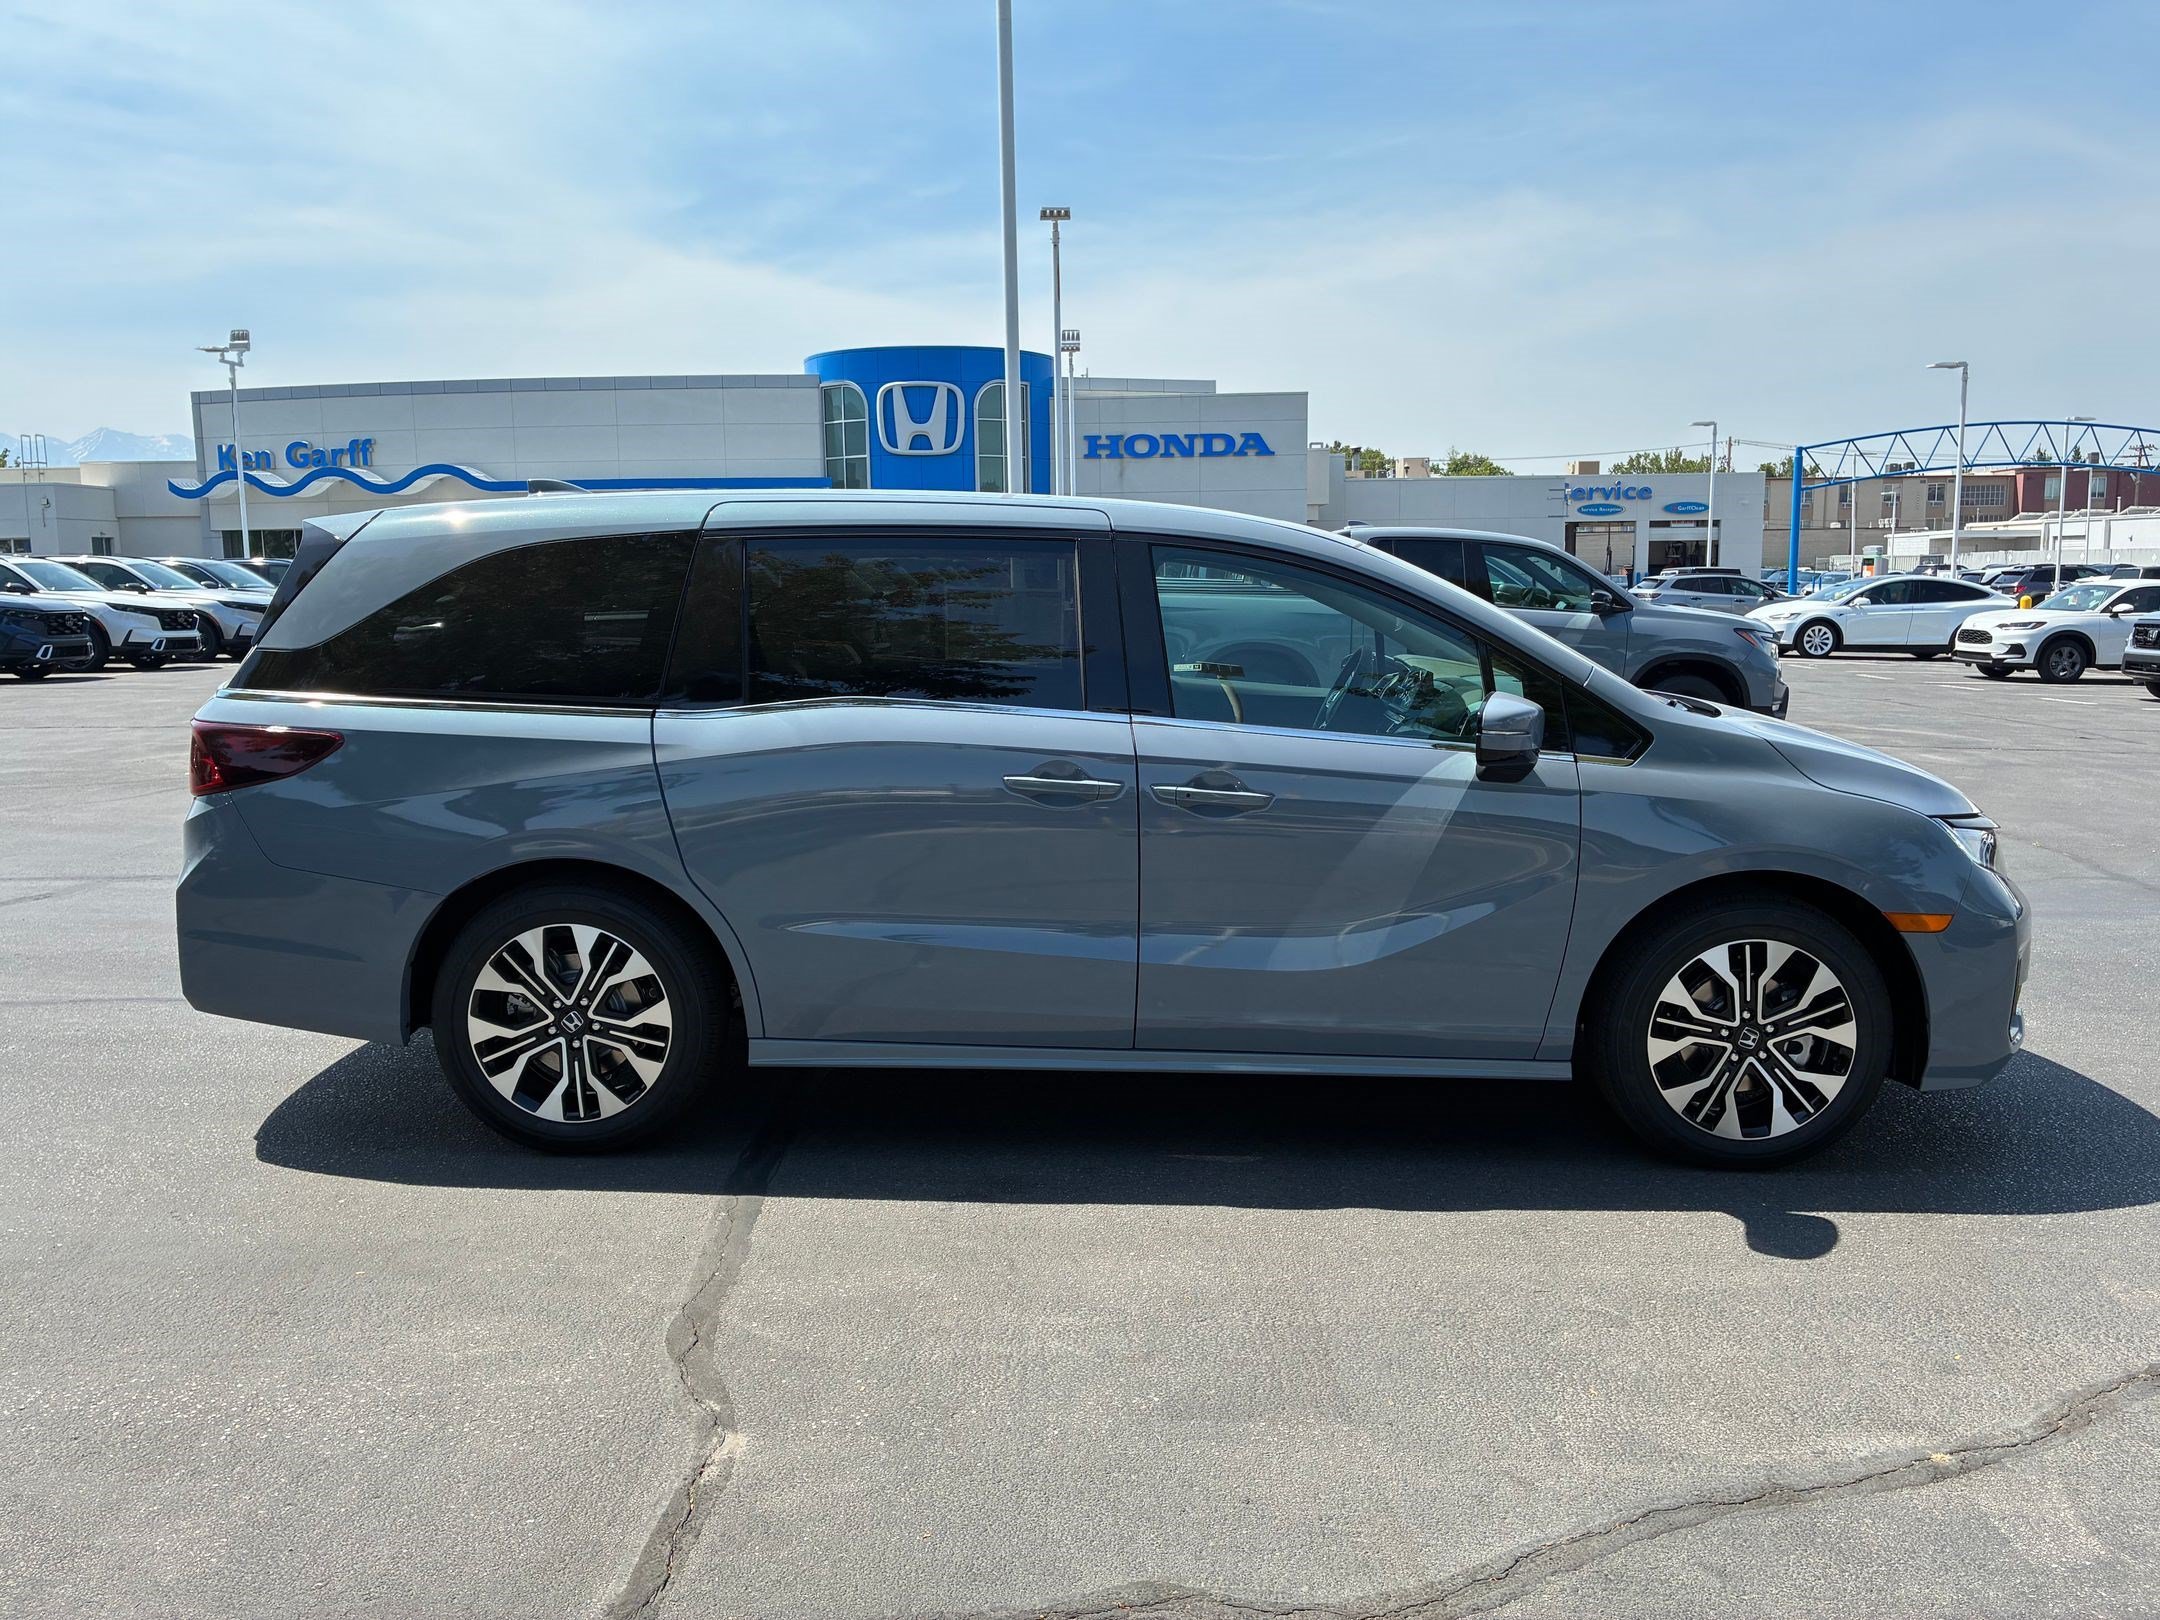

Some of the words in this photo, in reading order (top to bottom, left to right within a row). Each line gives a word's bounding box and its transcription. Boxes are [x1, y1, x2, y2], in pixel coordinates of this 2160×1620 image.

[217, 443, 273, 471] Ken
[285, 438, 374, 469] Garff
[1083, 432, 1275, 459] HONDA
